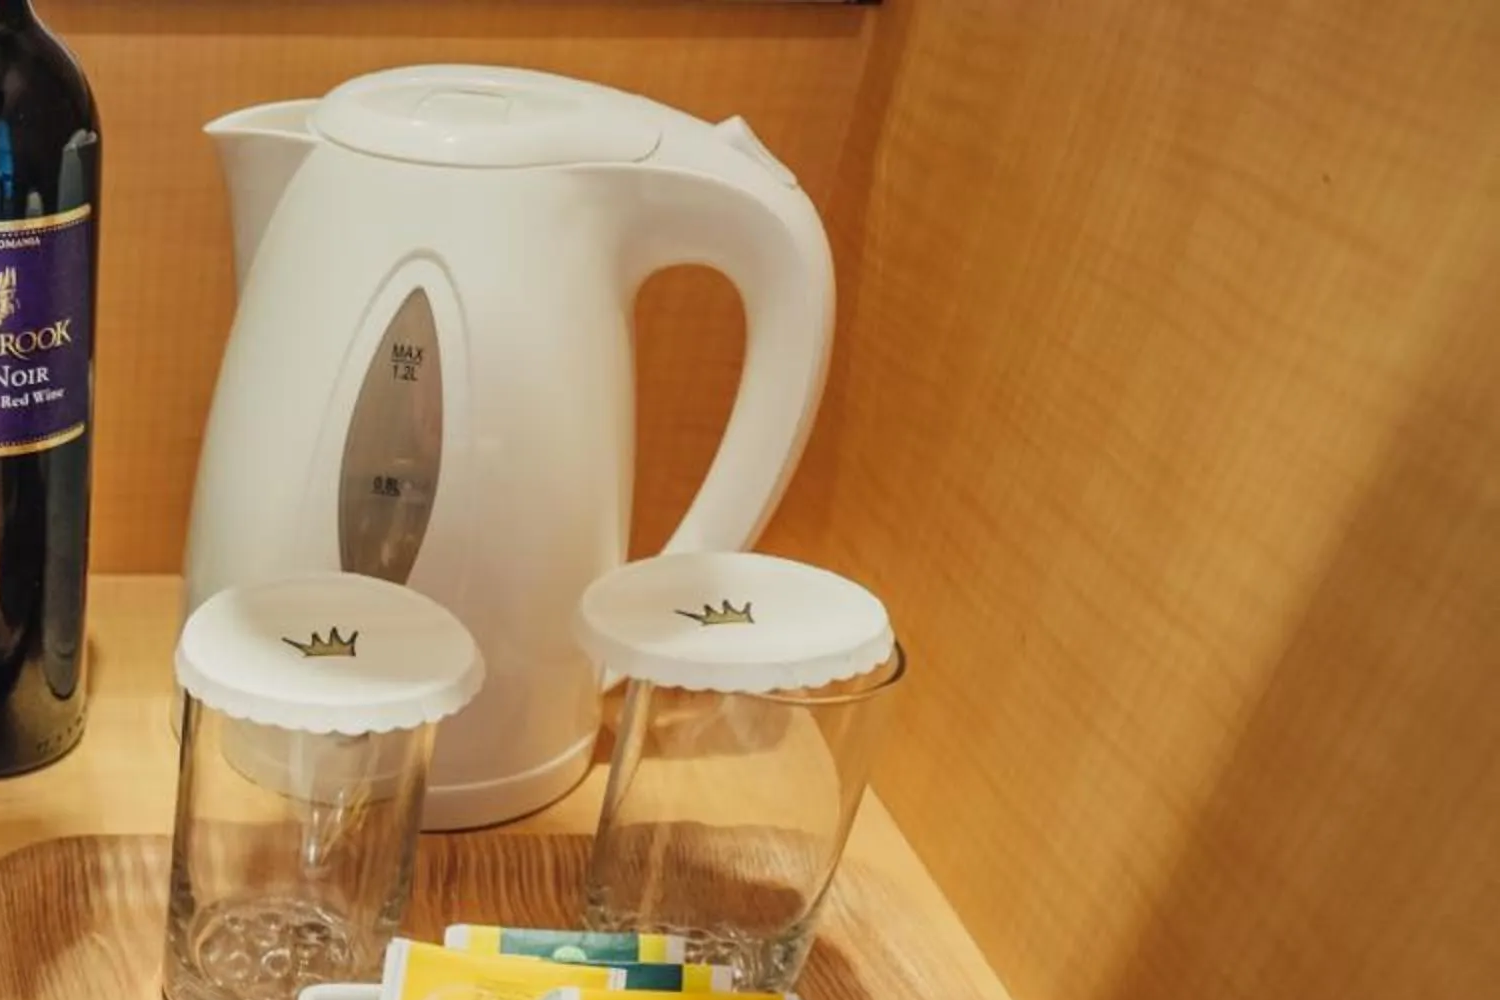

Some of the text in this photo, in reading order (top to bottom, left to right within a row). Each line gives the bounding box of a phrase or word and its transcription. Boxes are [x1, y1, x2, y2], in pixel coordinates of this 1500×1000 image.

[391, 343, 424, 362] MAX
[1, 395, 29, 409] Red
[33, 387, 65, 404] Wine
